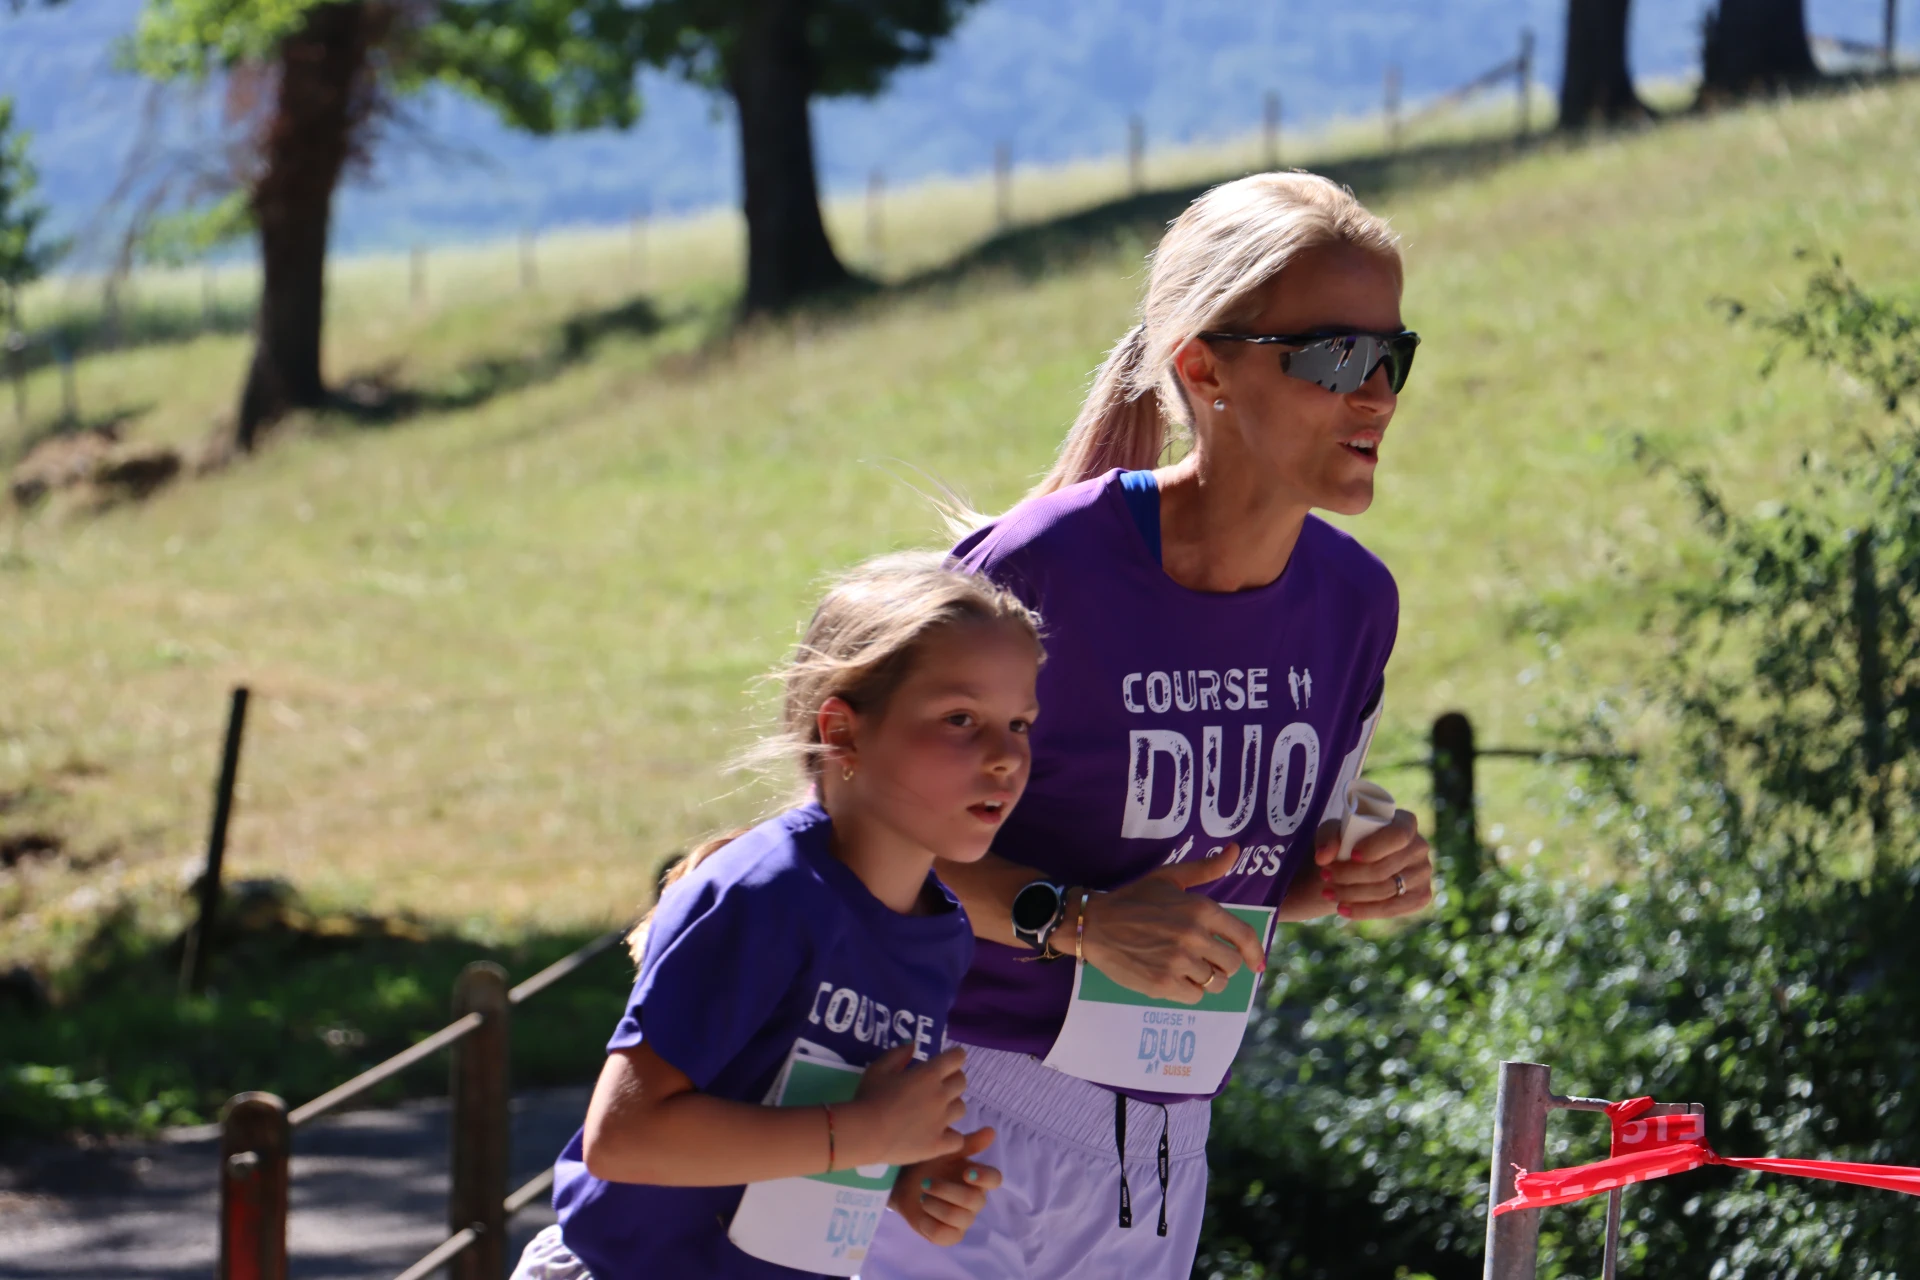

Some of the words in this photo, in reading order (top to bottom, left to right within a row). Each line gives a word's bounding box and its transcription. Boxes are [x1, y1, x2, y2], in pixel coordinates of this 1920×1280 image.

[1122, 668, 1269, 714] COURSE
[1121, 722, 1320, 839] DUO
[1143, 1011, 1183, 1026] COURSE
[1137, 1027, 1196, 1064] DUO
[1163, 1064, 1192, 1077] SUISSE
